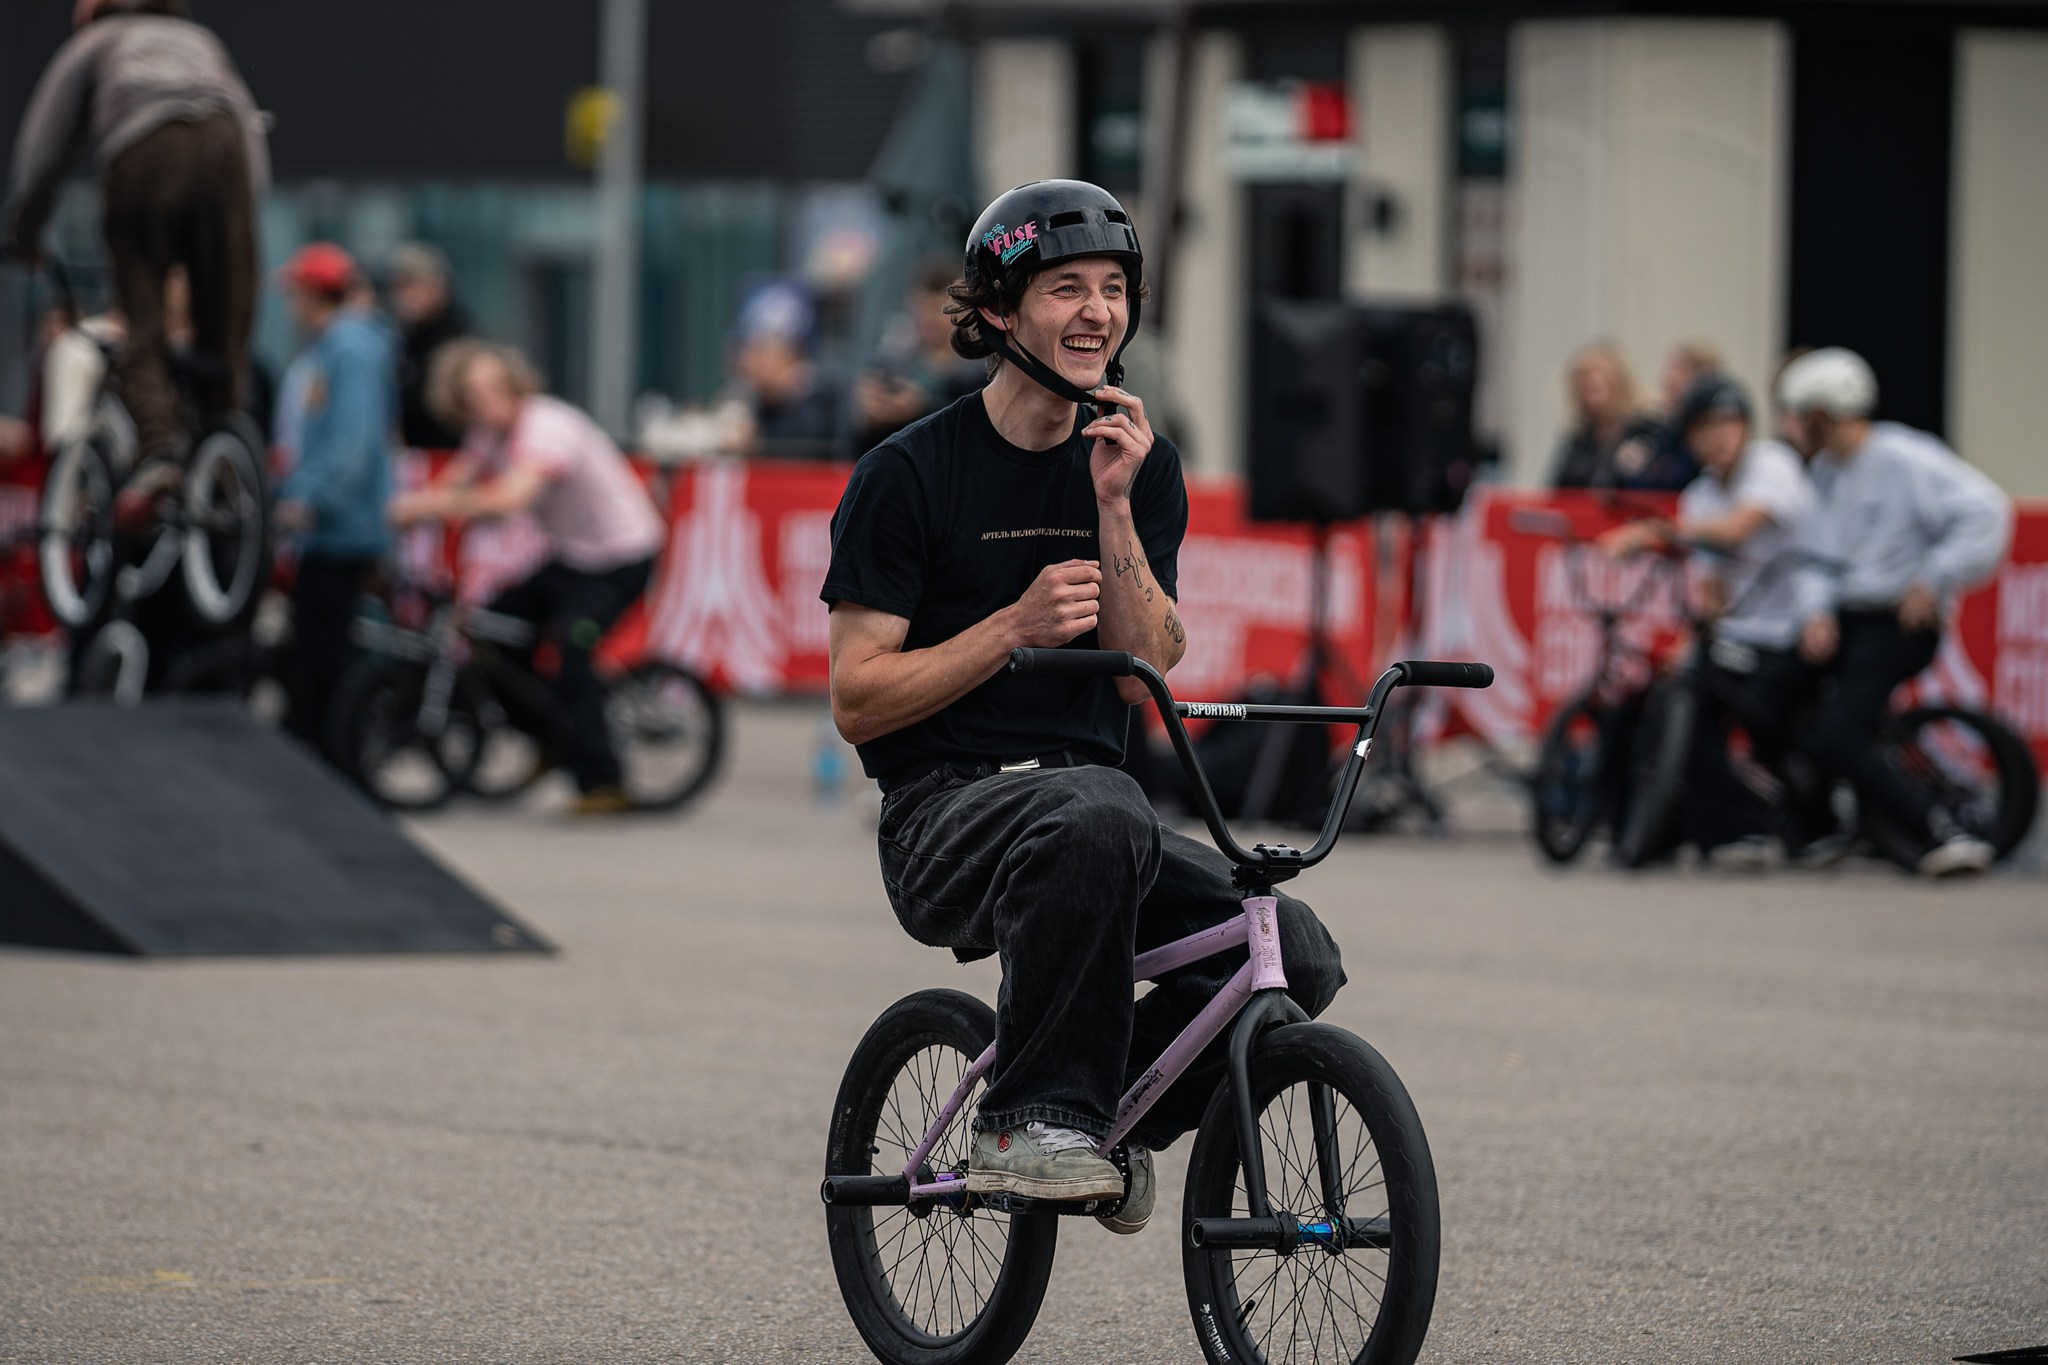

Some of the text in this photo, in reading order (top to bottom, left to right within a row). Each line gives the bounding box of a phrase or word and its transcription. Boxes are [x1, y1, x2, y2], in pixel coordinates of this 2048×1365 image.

[992, 221, 1038, 256] FUSE
[981, 530, 1010, 540] АРТЕЛЬ
[1061, 529, 1093, 538] СТРЕСС
[1191, 703, 1243, 717] SPORTBAR
